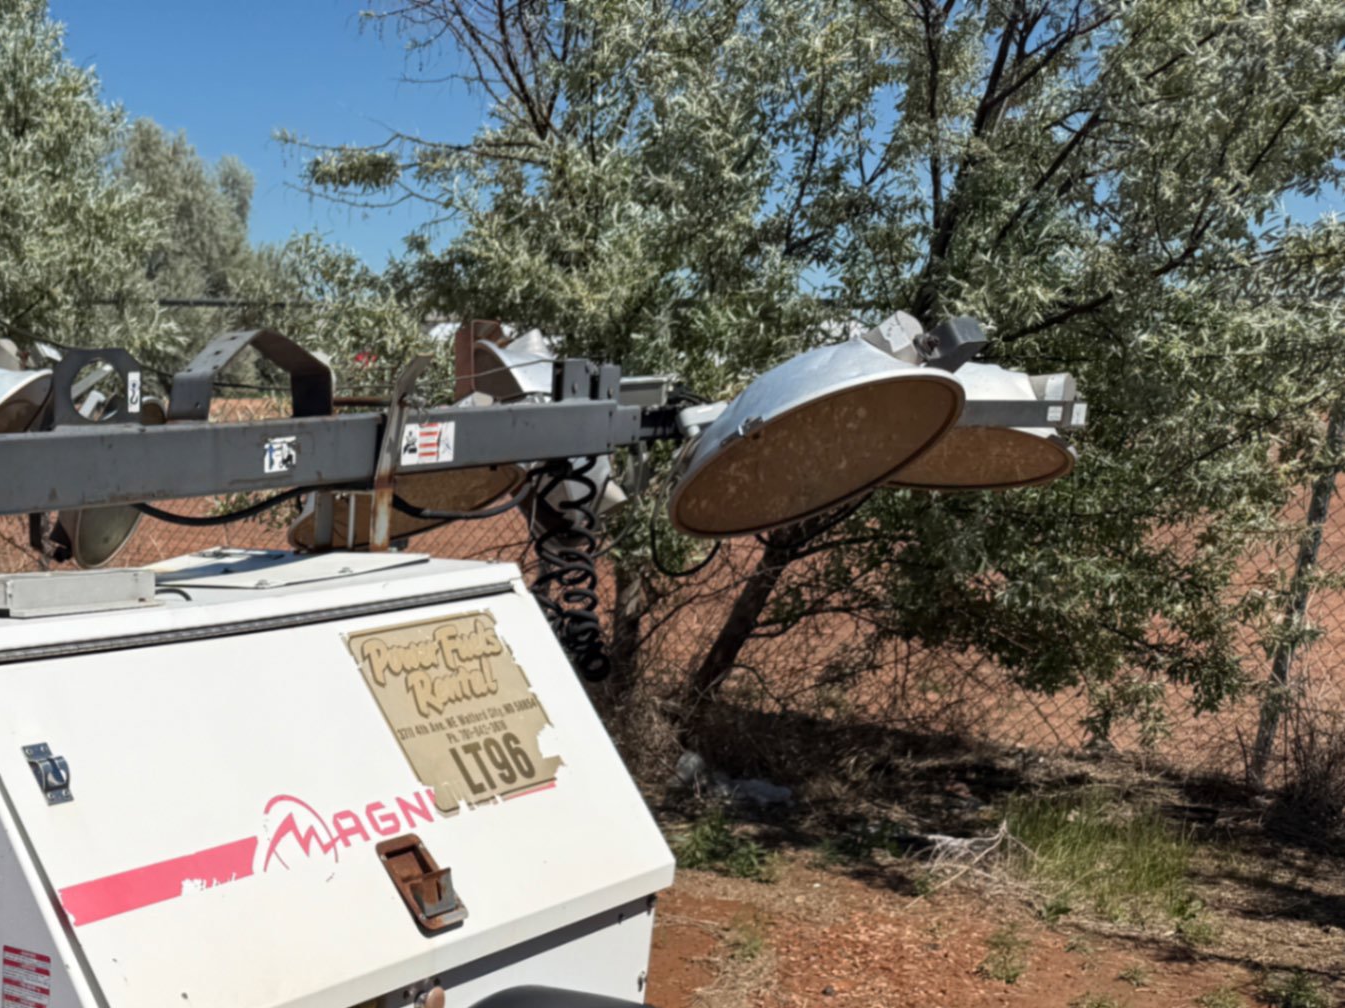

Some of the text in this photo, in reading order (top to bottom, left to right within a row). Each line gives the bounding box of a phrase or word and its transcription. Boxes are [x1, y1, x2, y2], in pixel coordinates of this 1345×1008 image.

[405, 657, 498, 718] Rental
[449, 732, 536, 796] LT96
[264, 789, 438, 872] MAGN
